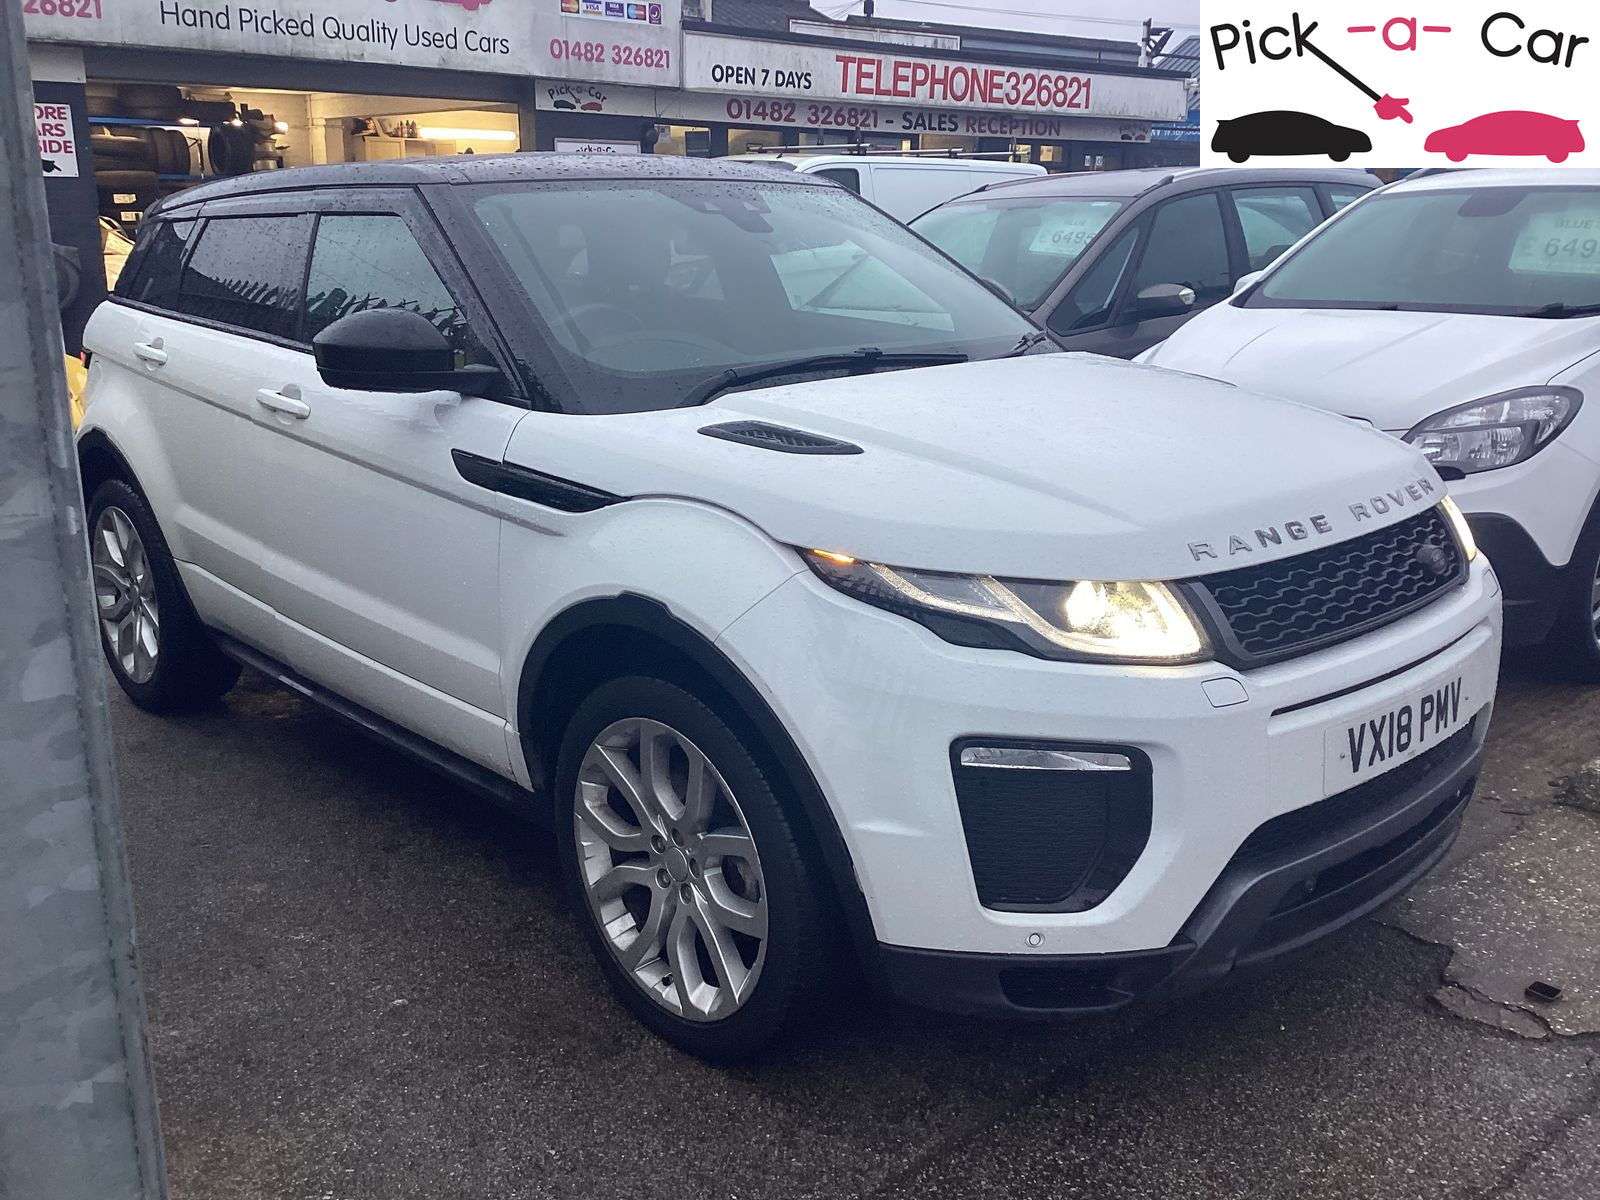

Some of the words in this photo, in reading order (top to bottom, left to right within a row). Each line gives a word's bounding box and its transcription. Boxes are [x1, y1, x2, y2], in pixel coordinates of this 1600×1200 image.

[160, 0, 230, 30] Hand
[239, 8, 315, 38] Picked
[322, 16, 398, 50] Quality
[404, 23, 458, 50] Used
[464, 30, 510, 54] Cars
[550, 38, 605, 63] 01482
[611, 44, 670, 69] 326821
[711, 64, 756, 87] OPEN
[761, 69, 770, 87] 7
[775, 70, 812, 90] DAYS
[38, 122, 66, 137] RS
[726, 99, 797, 122] 01482
[806, 104, 879, 128] 326821
[902, 111, 959, 133] SALES
[965, 115, 1062, 137] RECEPTION
[1187, 514, 1332, 562] RANGE
[1348, 477, 1435, 522] ROVER
[1347, 704, 1413, 774] VX18
[1419, 676, 1462, 742] PMV
